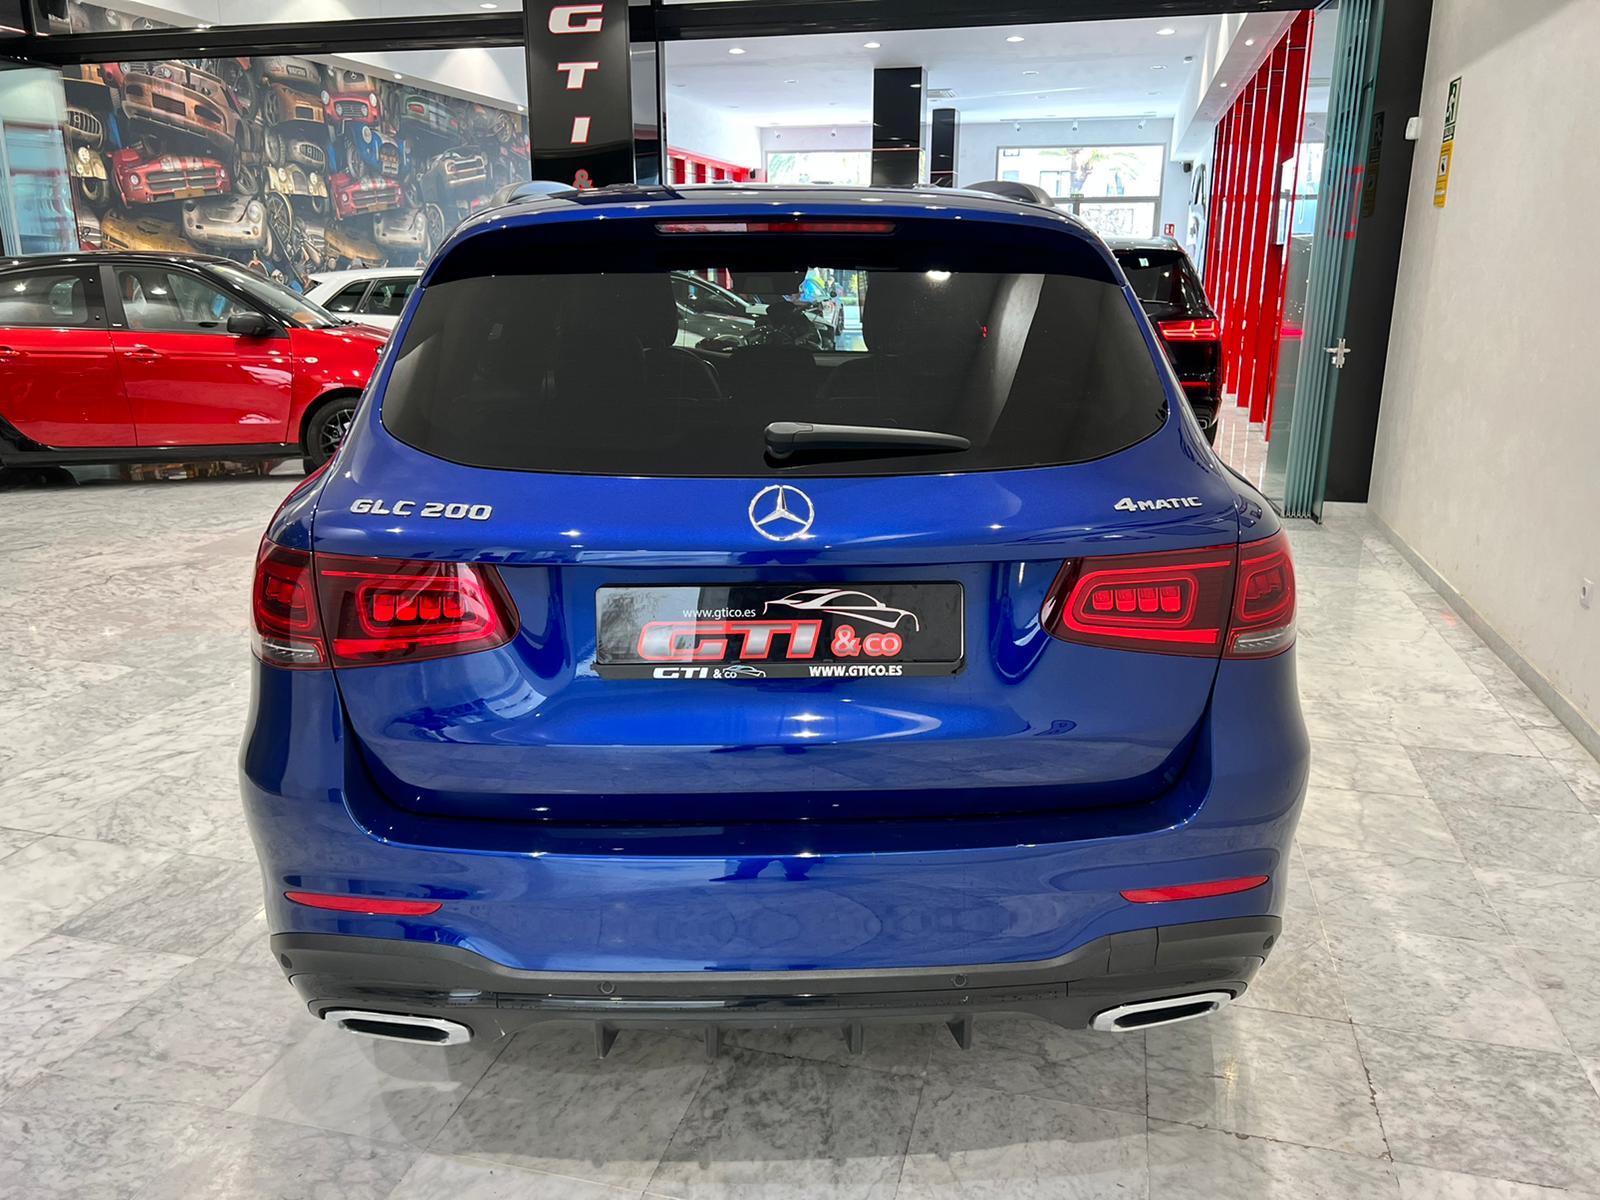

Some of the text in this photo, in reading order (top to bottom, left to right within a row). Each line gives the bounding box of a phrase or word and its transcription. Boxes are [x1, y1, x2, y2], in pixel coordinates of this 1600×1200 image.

[350, 499, 493, 521] GLC 200
[1113, 496, 1203, 512] 4MATIC
[682, 607, 757, 621] www.gtico.es
[637, 619, 823, 661] GTI
[653, 667, 709, 679] GTI
[808, 664, 903, 678] WWW.GTICO.ES
